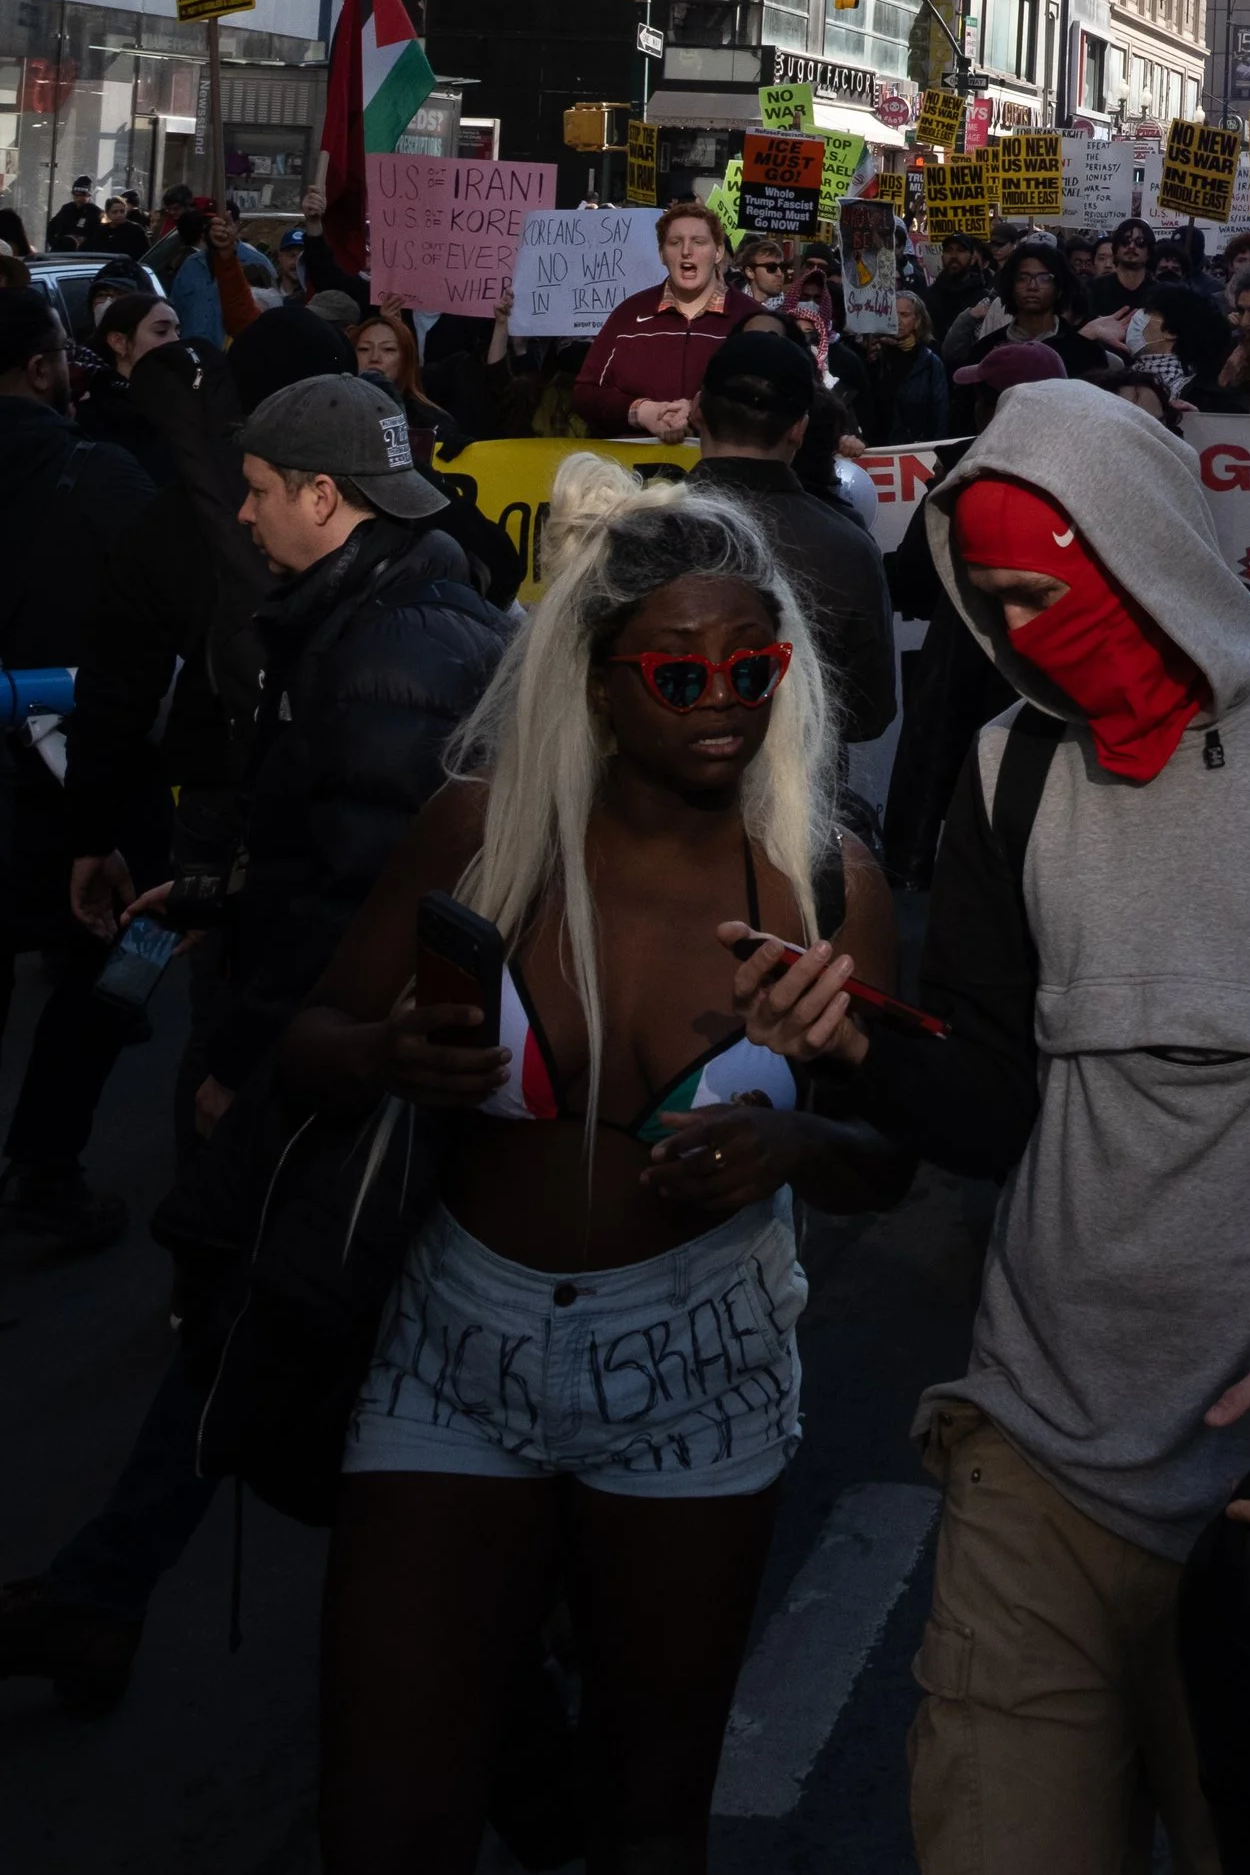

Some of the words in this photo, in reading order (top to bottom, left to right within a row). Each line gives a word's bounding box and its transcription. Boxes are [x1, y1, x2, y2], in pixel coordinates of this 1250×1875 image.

[826, 65, 879, 96] FACTORY
[968, 78, 984, 86] WAY
[767, 89, 793, 103] NO
[926, 91, 940, 105] NO
[942, 94, 964, 111] NEW
[194, 80, 211, 155] Newsstand
[765, 105, 807, 121] WAR
[924, 105, 937, 116] US
[938, 109, 960, 122] WAR
[920, 117, 933, 126] IN
[934, 119, 956, 132] THE
[755, 128, 817, 140] RefuseFascism.org
[918, 126, 940, 139] MIDDLE
[939, 130, 955, 141] EAST
[1062, 129, 1085, 140] RIGHT
[1171, 123, 1194, 148] NO
[1199, 128, 1238, 157] NEW
[768, 139, 804, 154] ICE
[824, 136, 852, 151] TOP
[1001, 138, 1022, 158] NO
[1026, 137, 1059, 158] NEW
[1087, 141, 1112, 150] EFEAT
[629, 143, 656, 162] WAR
[976, 149, 989, 163] NO
[1086, 153, 1099, 161] THE
[1168, 145, 1191, 164] US
[1193, 150, 1234, 175] WAR
[754, 153, 815, 169] MUST
[1002, 159, 1023, 173] US
[1023, 158, 1060, 172] WAR
[379, 161, 422, 201] U.S.
[454, 167, 544, 203] IRAN!
[764, 168, 803, 184] GO!
[927, 167, 945, 186] NO
[951, 165, 983, 185] NEW
[1002, 177, 1021, 190] IN
[1025, 177, 1059, 189] THE
[1165, 165, 1187, 182] IN
[1190, 172, 1231, 195] THE
[764, 185, 796, 198] Whole
[928, 187, 948, 201] US
[949, 185, 985, 200] WAR
[1002, 192, 1036, 206] MIDDLE
[1037, 191, 1059, 205] EAST
[1163, 181, 1200, 207] MIDDLE
[1203, 191, 1228, 211] EAST
[744, 195, 775, 208] Trump
[778, 198, 814, 211] Fascist
[746, 207, 783, 220] Regime
[785, 210, 810, 221] Must
[929, 207, 948, 218] IN
[949, 205, 986, 217] THE
[1084, 211, 1127, 219] REVOLUTION
[450, 208, 522, 236] KORE
[754, 218, 769, 228] Go
[770, 220, 800, 231] NOW!
[930, 220, 963, 233] MIDDLE
[965, 218, 986, 232] EAST
[600, 217, 633, 245] SAY
[381, 237, 418, 271] U.S.
[422, 241, 445, 251] OUT
[422, 253, 441, 266] OF
[446, 242, 518, 271] EVER
[538, 251, 569, 284] NO
[582, 248, 627, 281] WAR
[445, 276, 514, 303] WHER
[532, 290, 550, 315] IN
[572, 287, 628, 313] IRAN!
[588, 1253, 791, 1425] ISRAEL
